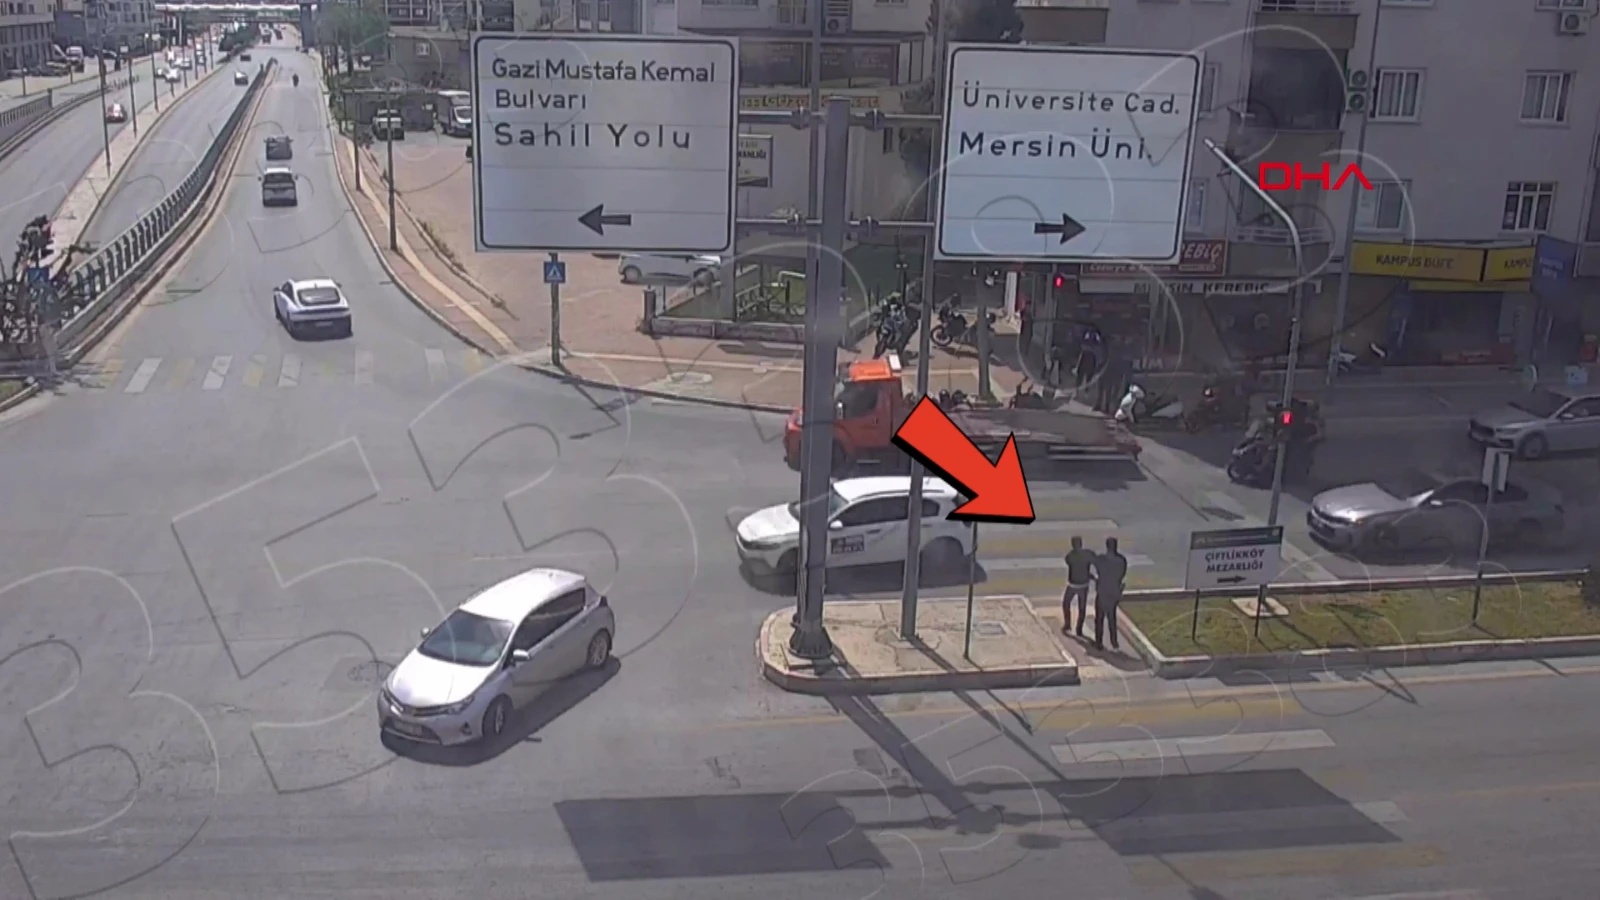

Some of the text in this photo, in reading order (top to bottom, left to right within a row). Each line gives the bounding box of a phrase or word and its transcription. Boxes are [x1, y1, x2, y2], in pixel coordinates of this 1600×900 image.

[492, 58, 715, 83] Gazi Mustafa Kemal
[495, 89, 587, 109] Bulvarı
[963, 80, 1180, 115] Üniversite Cad.
[494, 122, 691, 149] Sahil Yolu
[959, 127, 1152, 160] Mersin Üni.
